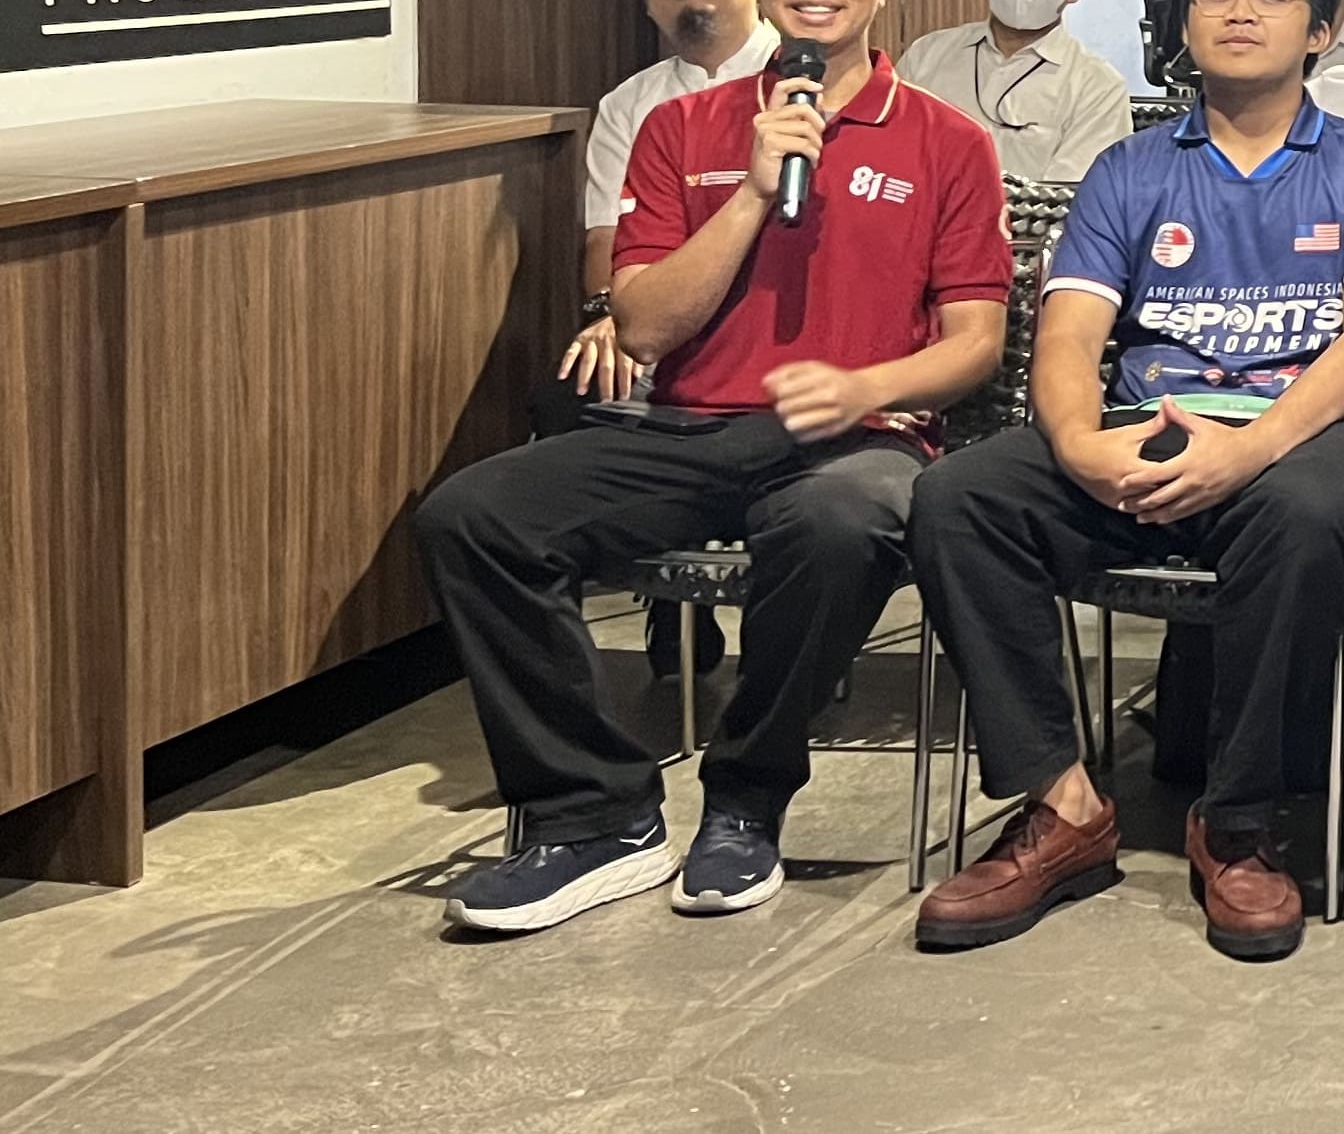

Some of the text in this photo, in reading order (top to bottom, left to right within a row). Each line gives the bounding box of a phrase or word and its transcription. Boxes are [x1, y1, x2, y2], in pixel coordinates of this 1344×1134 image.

[849, 166, 886, 202] 81
[1145, 282, 1344, 301] AMERICAN SPACES INDONESIA
[1138, 298, 1344, 334] ESPORTS
